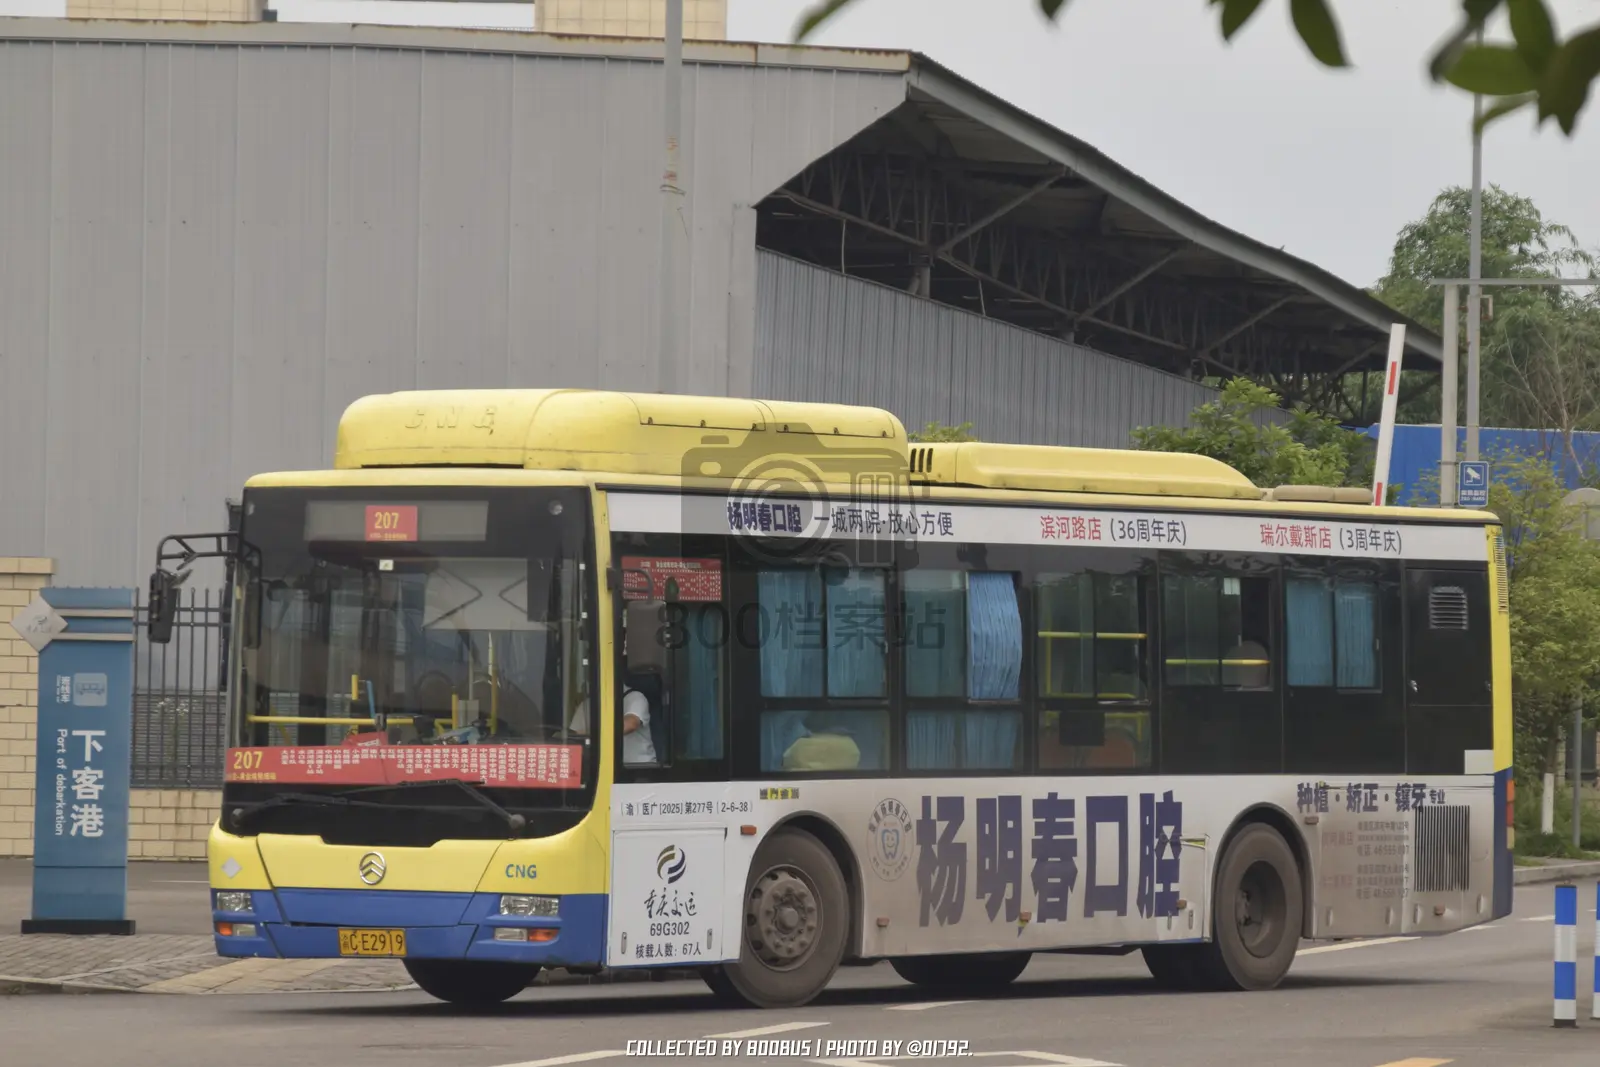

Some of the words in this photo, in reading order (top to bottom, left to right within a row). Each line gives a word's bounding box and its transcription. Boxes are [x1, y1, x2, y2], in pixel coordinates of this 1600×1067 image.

[374, 511, 399, 529] 207
[727, 501, 802, 533] 杨明春口腔
[814, 508, 955, 537] 一城两院·放心方便
[1040, 515, 1102, 541] 滨河路店
[1260, 523, 1332, 550] 瑞尔戴斯店
[56, 729, 68, 754] Port
[56, 757, 67, 770] of
[233, 751, 263, 769] 207
[70, 729, 107, 838] 下客港
[1430, 789, 1446, 805] 专业
[505, 863, 538, 880] CNG
[916, 790, 1183, 928] 杨明春口腔
[643, 887, 698, 918] 重庆交运
[650, 921, 690, 937] 69G302
